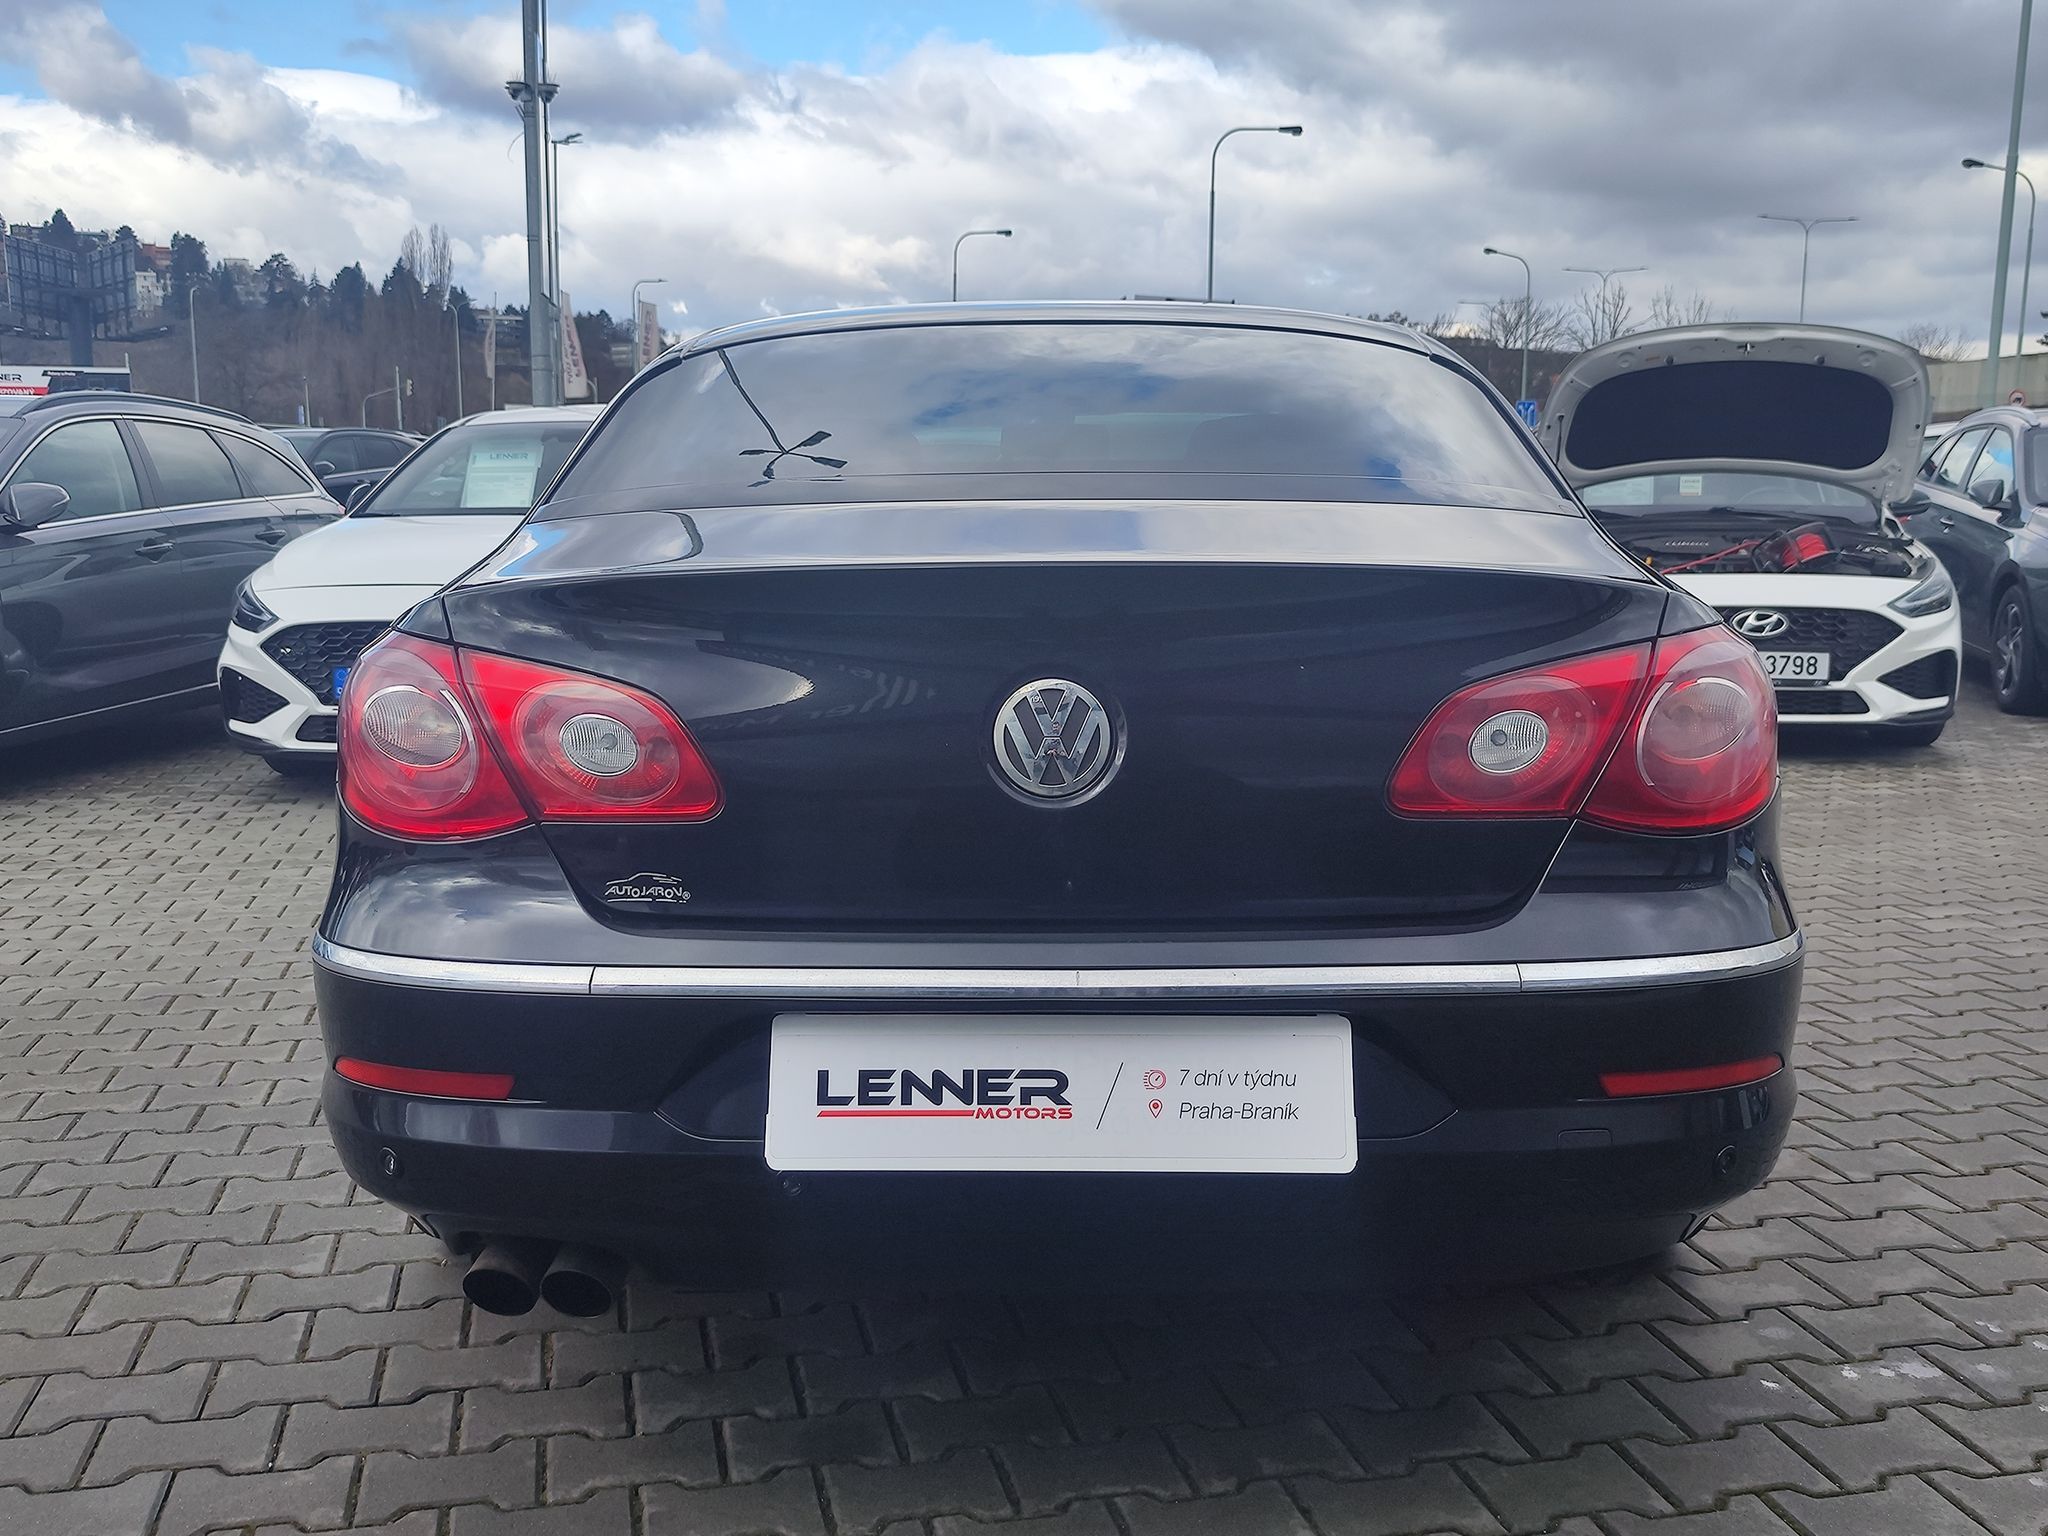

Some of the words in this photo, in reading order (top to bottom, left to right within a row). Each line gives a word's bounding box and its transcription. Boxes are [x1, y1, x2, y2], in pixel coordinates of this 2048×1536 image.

[1766, 655, 1818, 675] 3798
[816, 1069, 1073, 1106] LENNER
[1179, 1069, 1190, 1086] 7
[1194, 1069, 1225, 1086] dní
[1228, 1073, 1239, 1086] v
[1244, 1069, 1297, 1090] týdnu
[975, 1107, 1073, 1119] MOTORS
[1179, 1102, 1299, 1120] Praha-Braník
